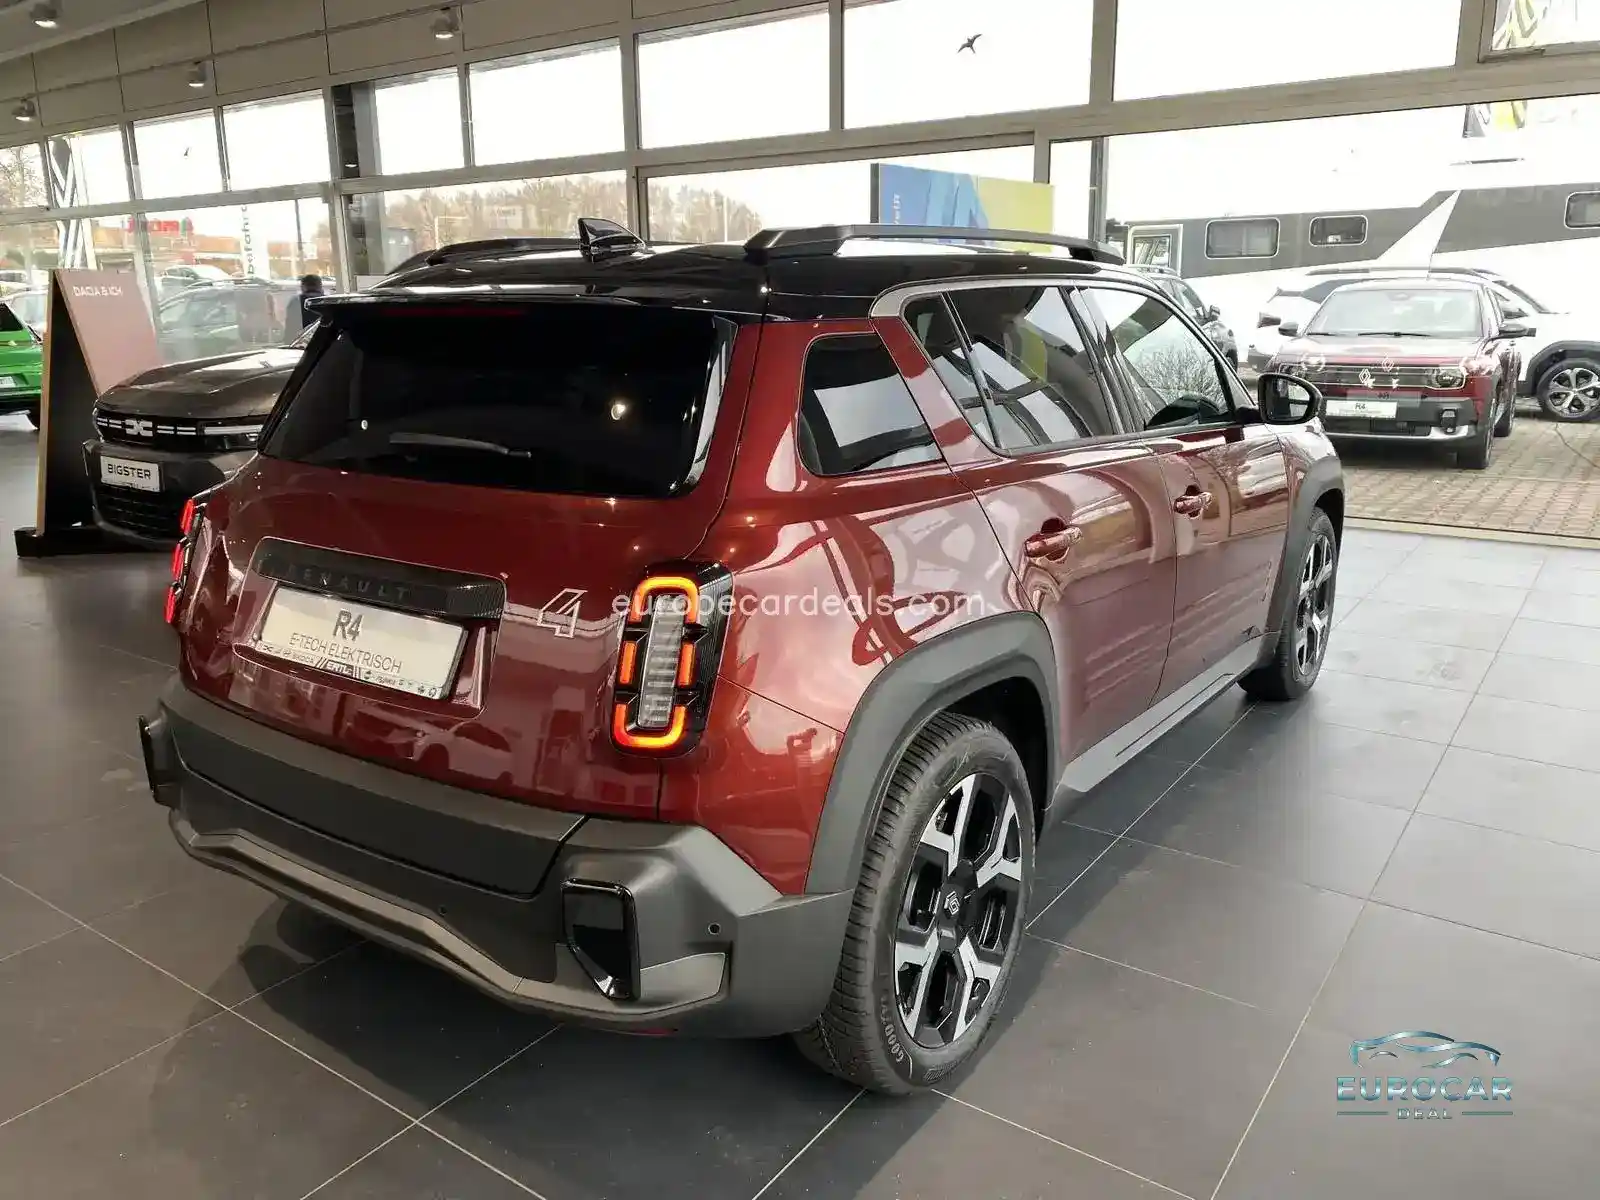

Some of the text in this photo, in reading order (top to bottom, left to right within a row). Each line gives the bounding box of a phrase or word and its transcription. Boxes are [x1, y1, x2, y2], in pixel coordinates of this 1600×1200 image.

[72, 285, 100, 297] DACIA
[107, 463, 151, 480] BIGSTER
[332, 609, 364, 641] R4
[289, 631, 402, 674] E-TECH ELEKTRISCH
